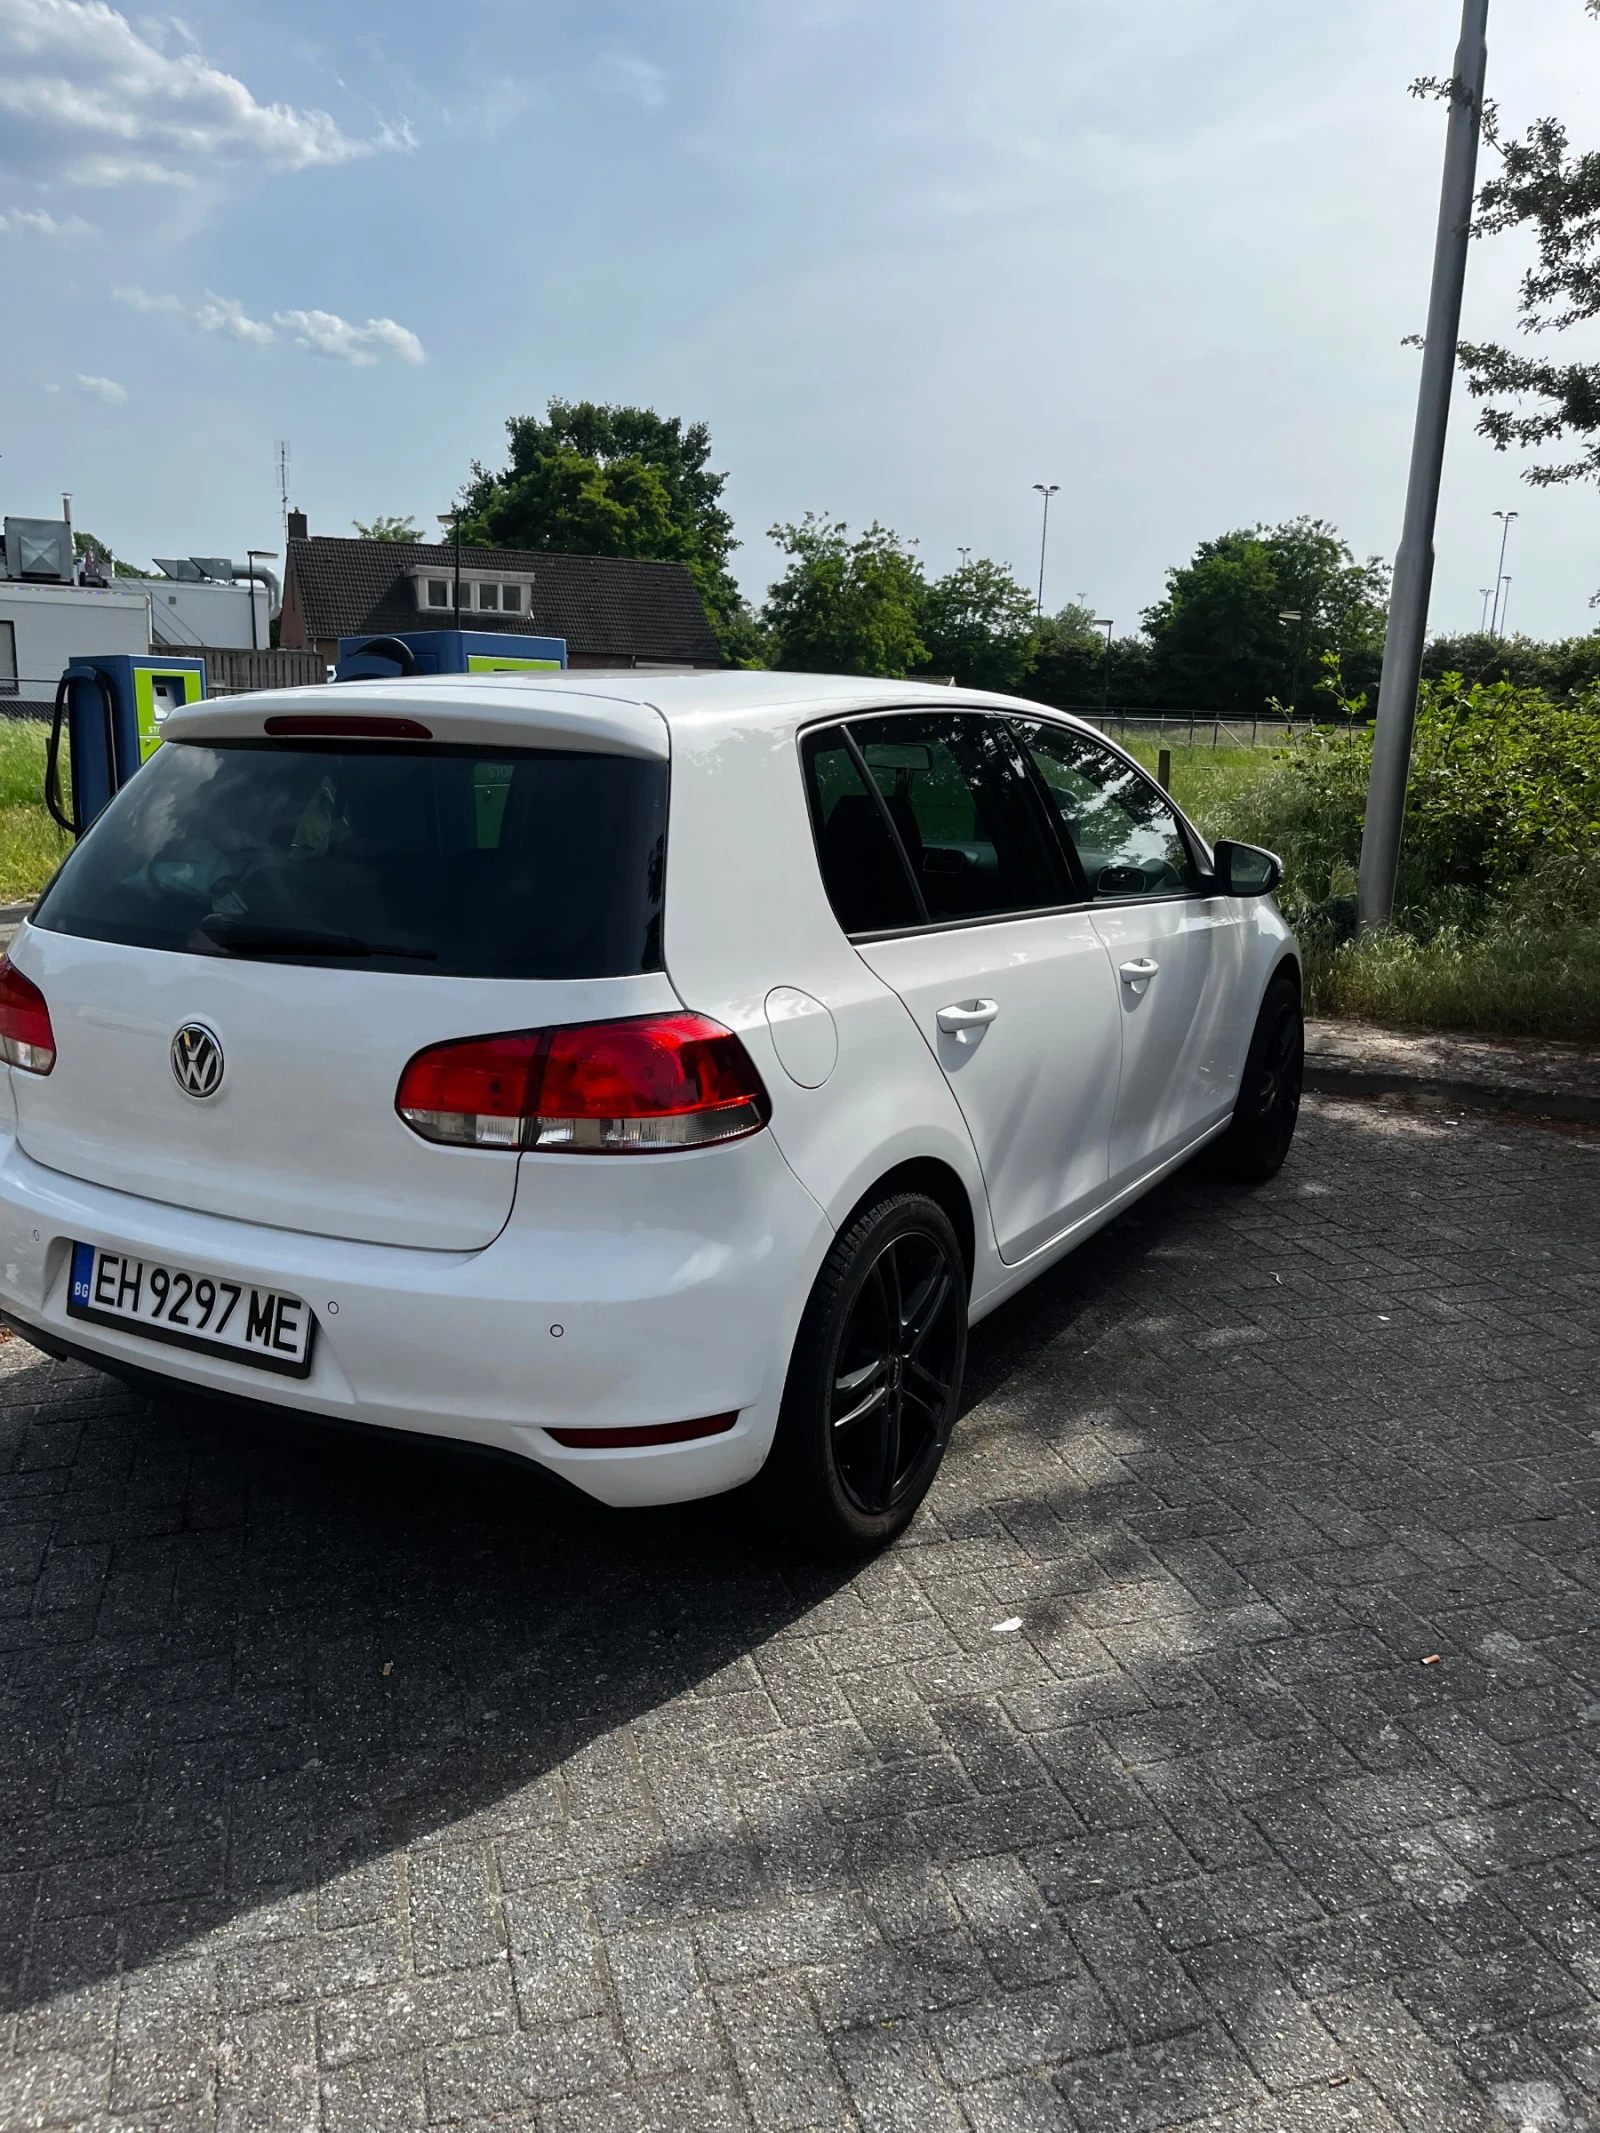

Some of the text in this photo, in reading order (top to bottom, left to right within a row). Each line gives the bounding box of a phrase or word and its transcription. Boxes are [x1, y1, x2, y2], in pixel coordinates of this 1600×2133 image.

[171, 1022, 224, 1097] VW
[74, 1281, 89, 1298] BG
[94, 1253, 302, 1354] EH 9297 ME
